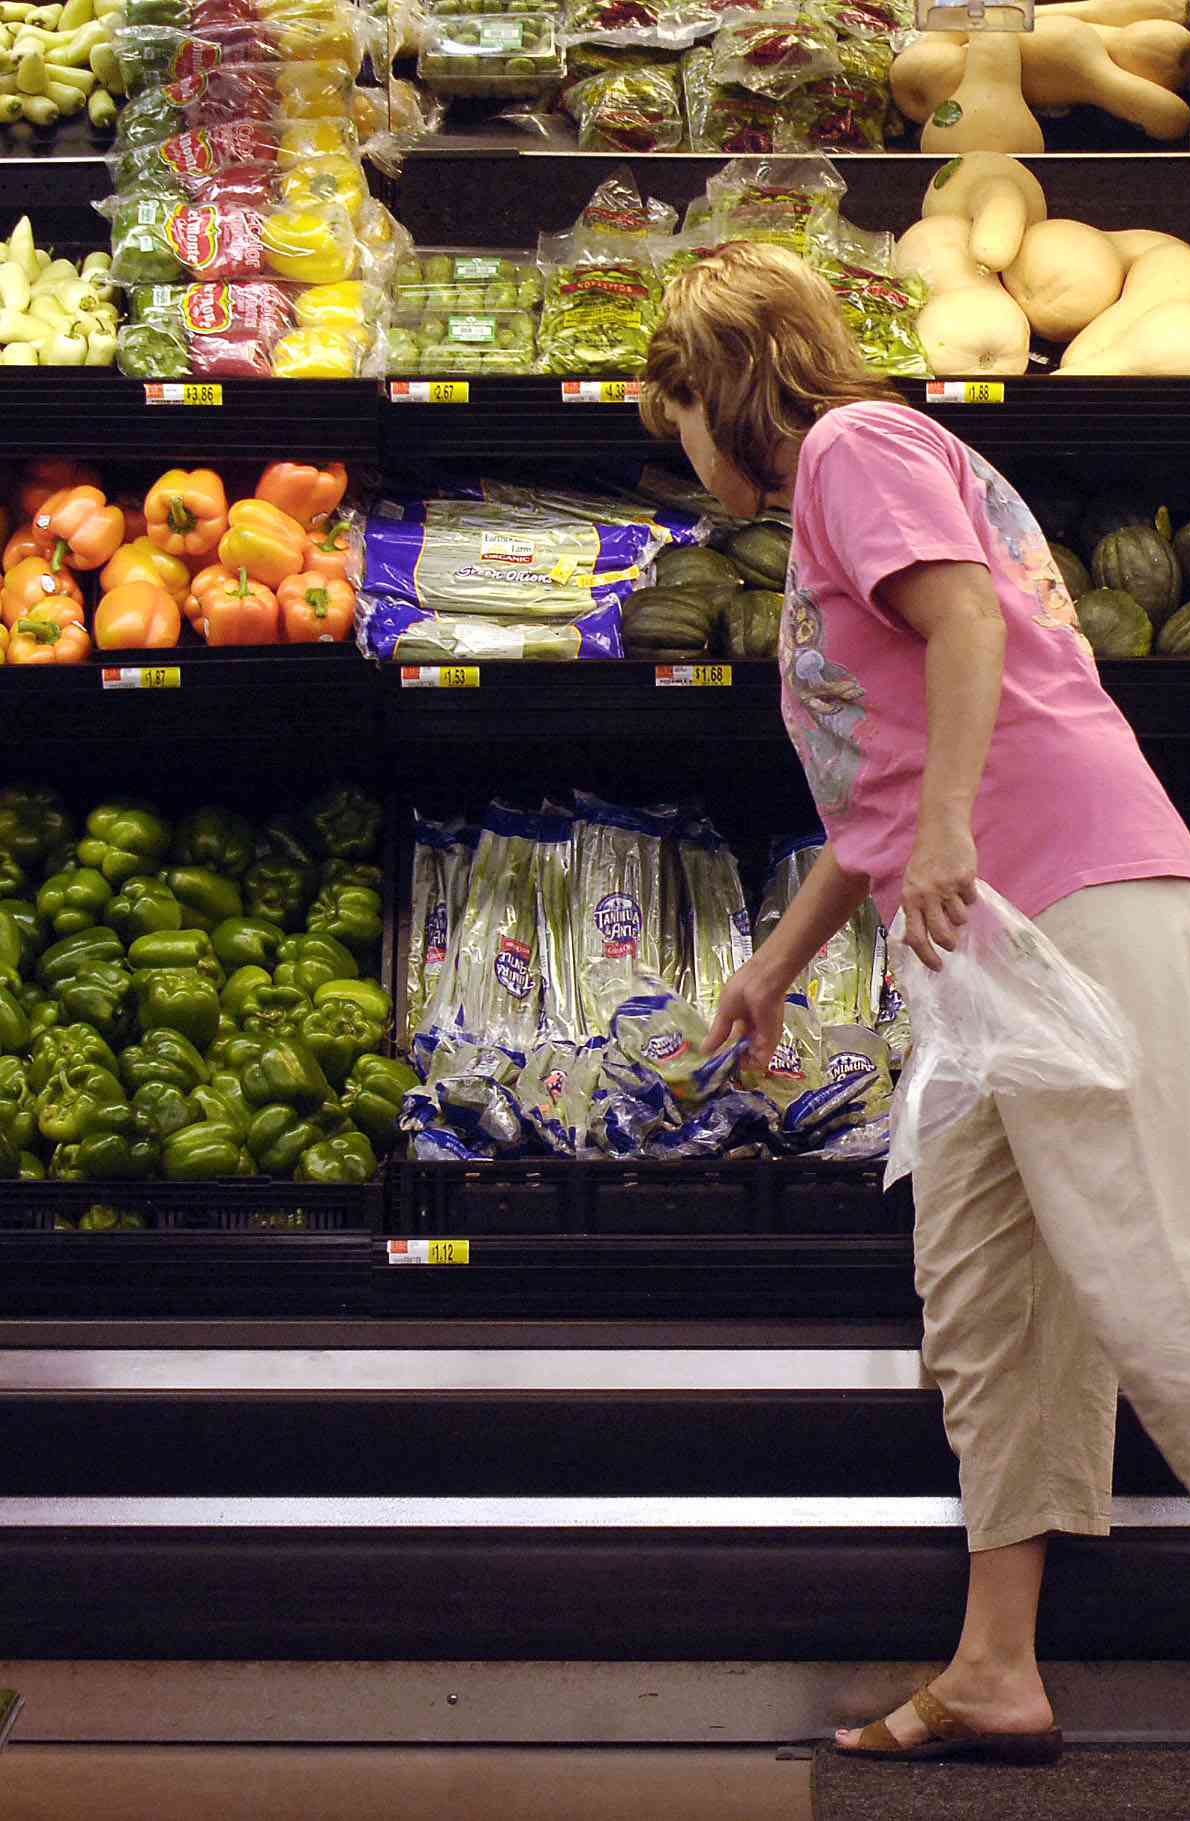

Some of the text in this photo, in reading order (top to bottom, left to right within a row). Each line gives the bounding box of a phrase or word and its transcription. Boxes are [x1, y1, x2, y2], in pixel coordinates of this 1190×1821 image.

[186, 387, 214, 402] $3.86
[484, 553, 531, 563] ORGANIC
[695, 667, 723, 682] $1.68
